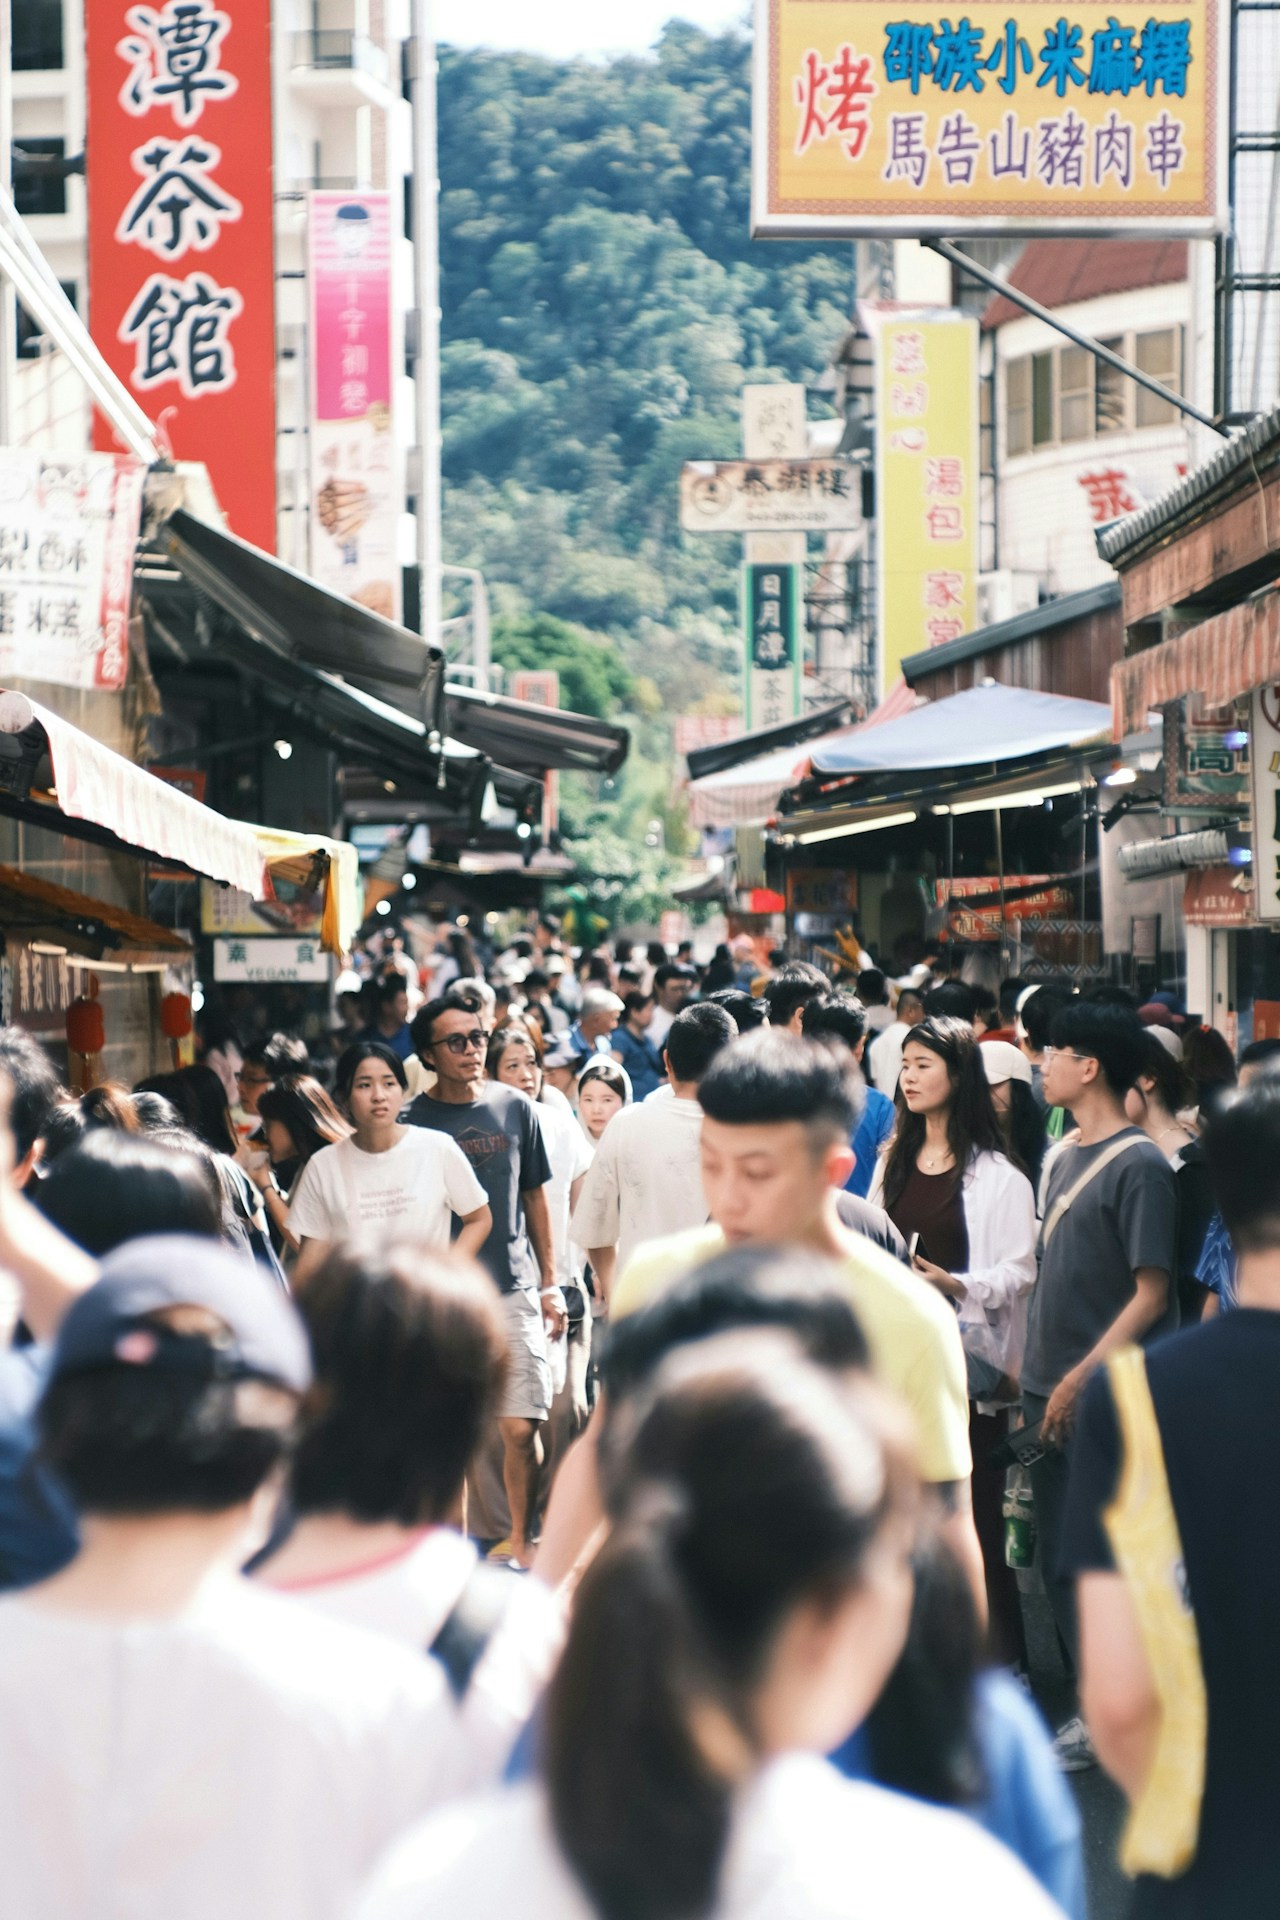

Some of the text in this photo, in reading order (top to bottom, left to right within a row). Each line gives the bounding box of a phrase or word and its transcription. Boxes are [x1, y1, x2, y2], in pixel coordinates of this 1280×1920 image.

[883, 17, 1192, 97] 邵族小米麻糬
[798, 46, 874, 158] 烤
[885, 111, 1184, 188] 馬告山豬肉串
[125, 3, 235, 389] 潭茶館
[228, 942, 315, 963] 素食
[245, 967, 298, 979] VEGAN
